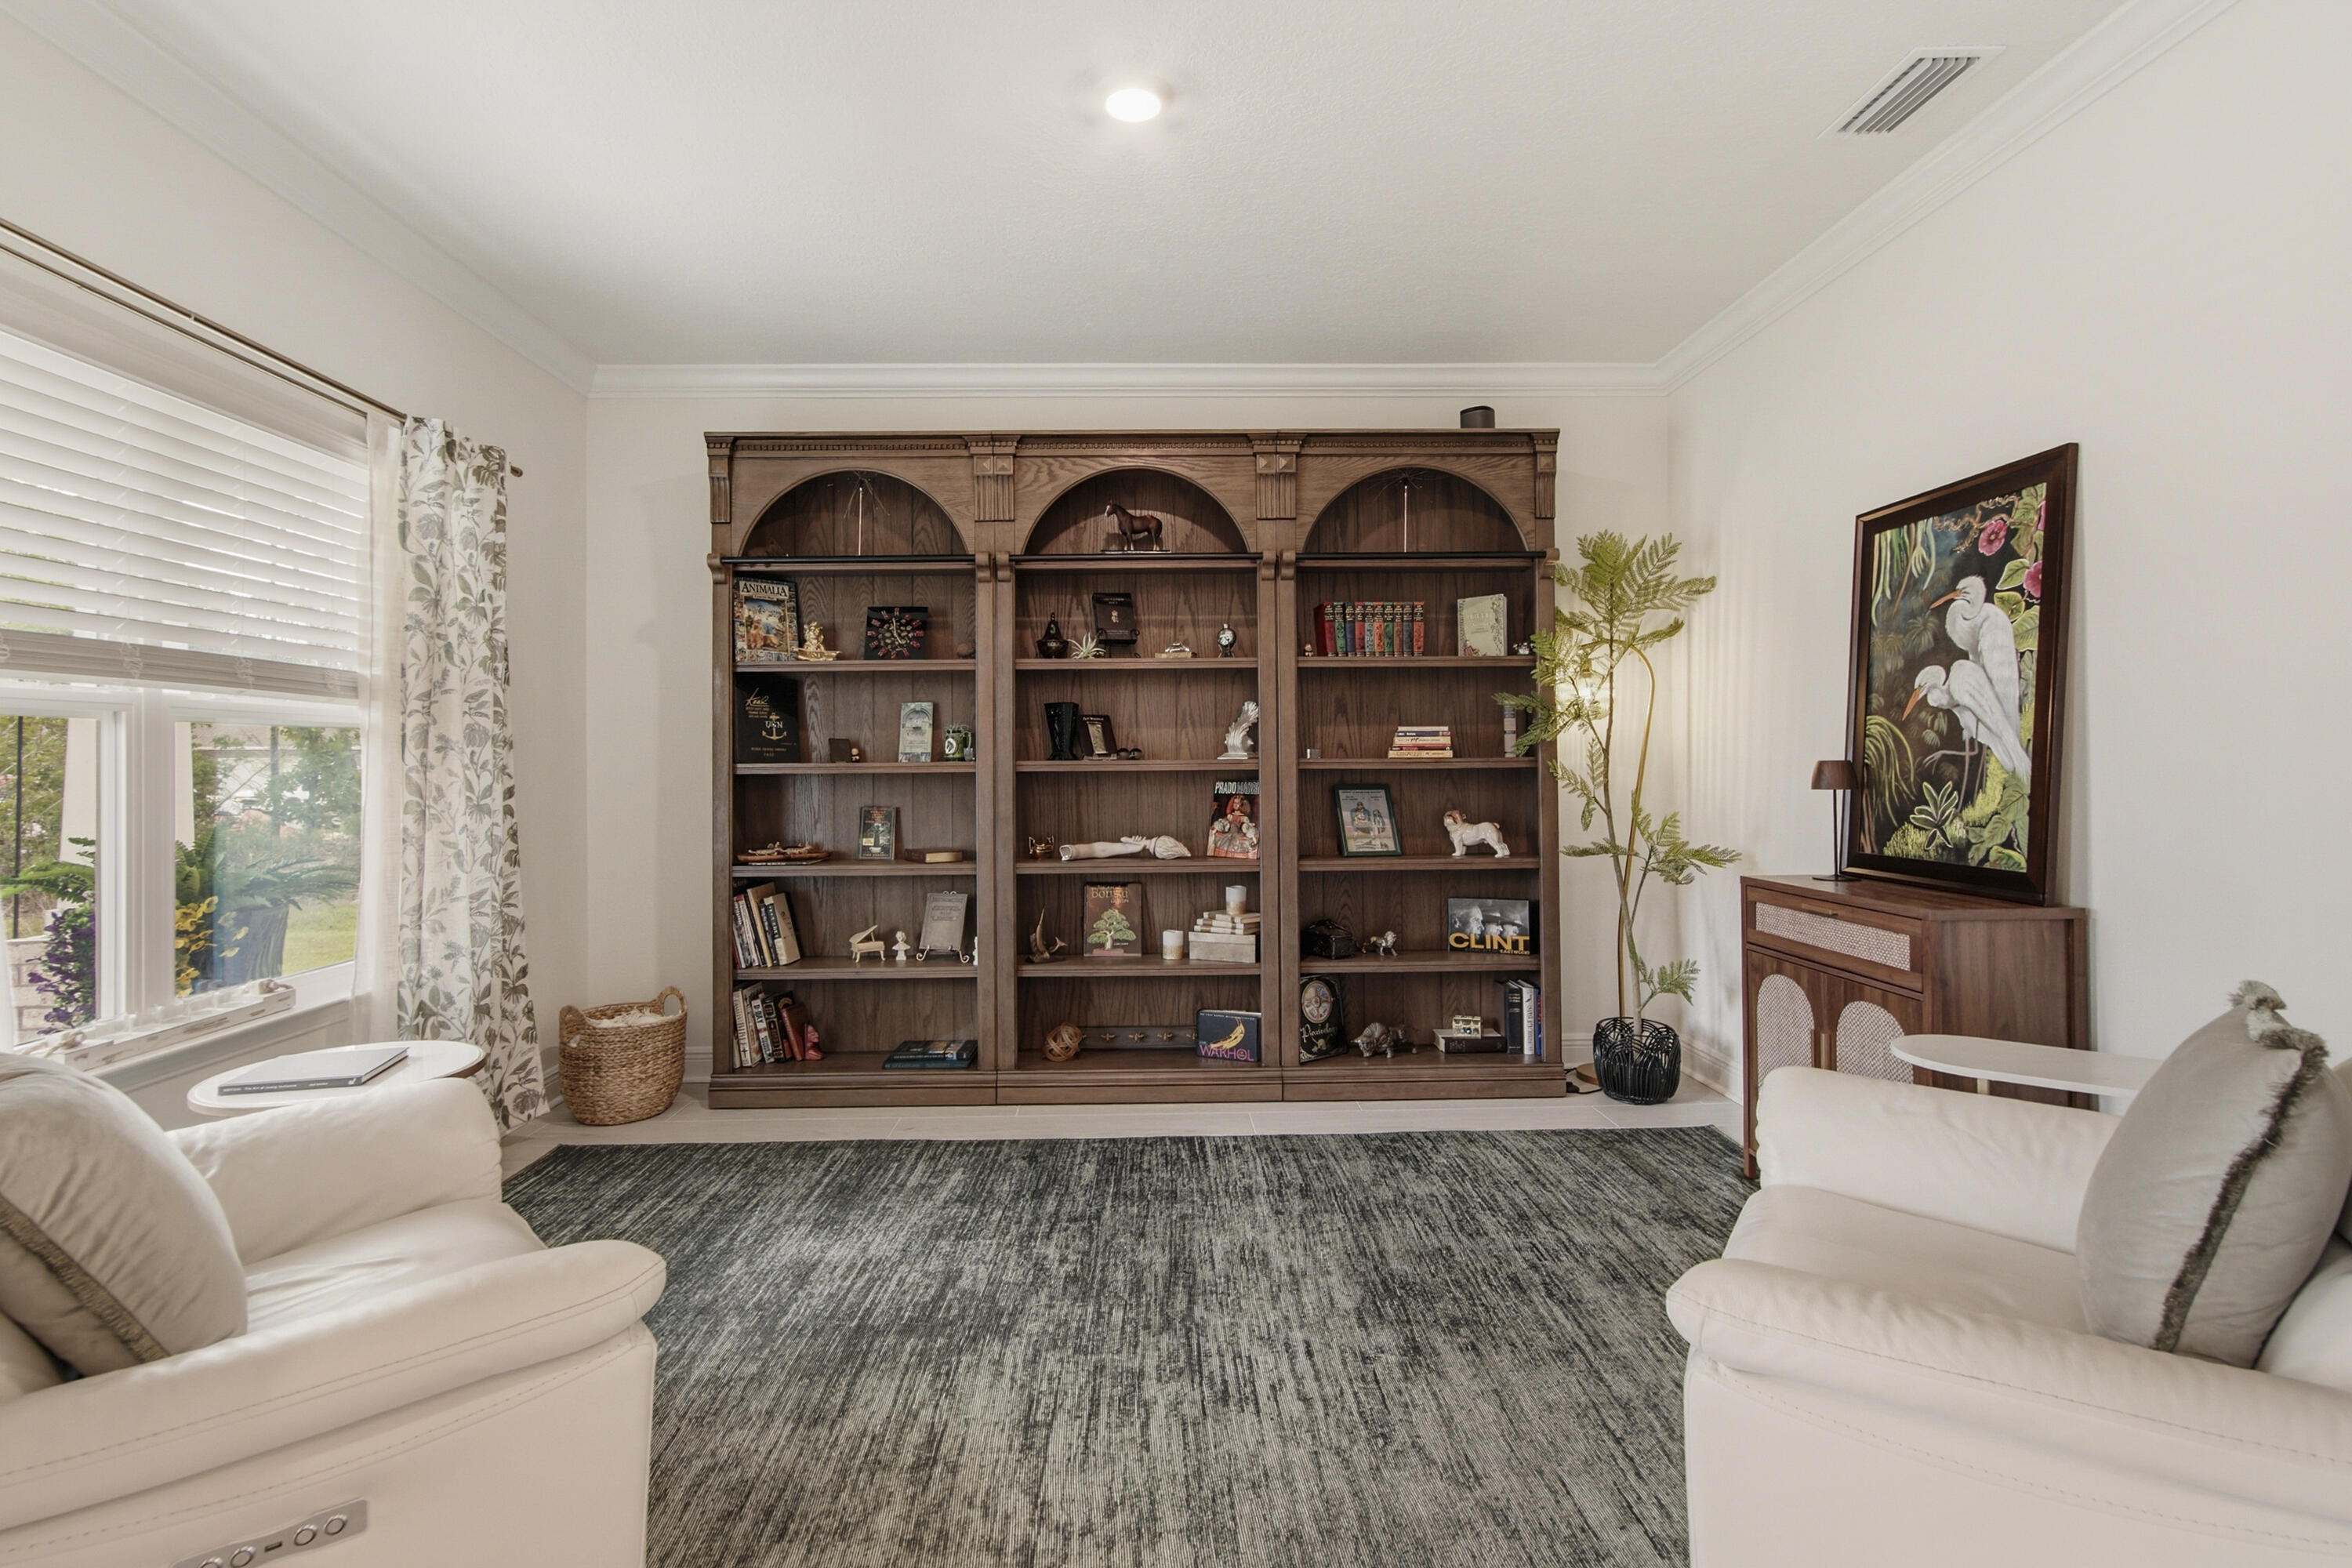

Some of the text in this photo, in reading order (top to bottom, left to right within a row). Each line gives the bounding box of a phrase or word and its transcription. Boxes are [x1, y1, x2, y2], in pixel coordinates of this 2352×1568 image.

[741, 582, 788, 597] ANIMALIA
[1214, 781, 1236, 794] PRADO
[1449, 932, 1530, 953] CLINT
[1200, 1044, 1254, 1062] WARHOL
